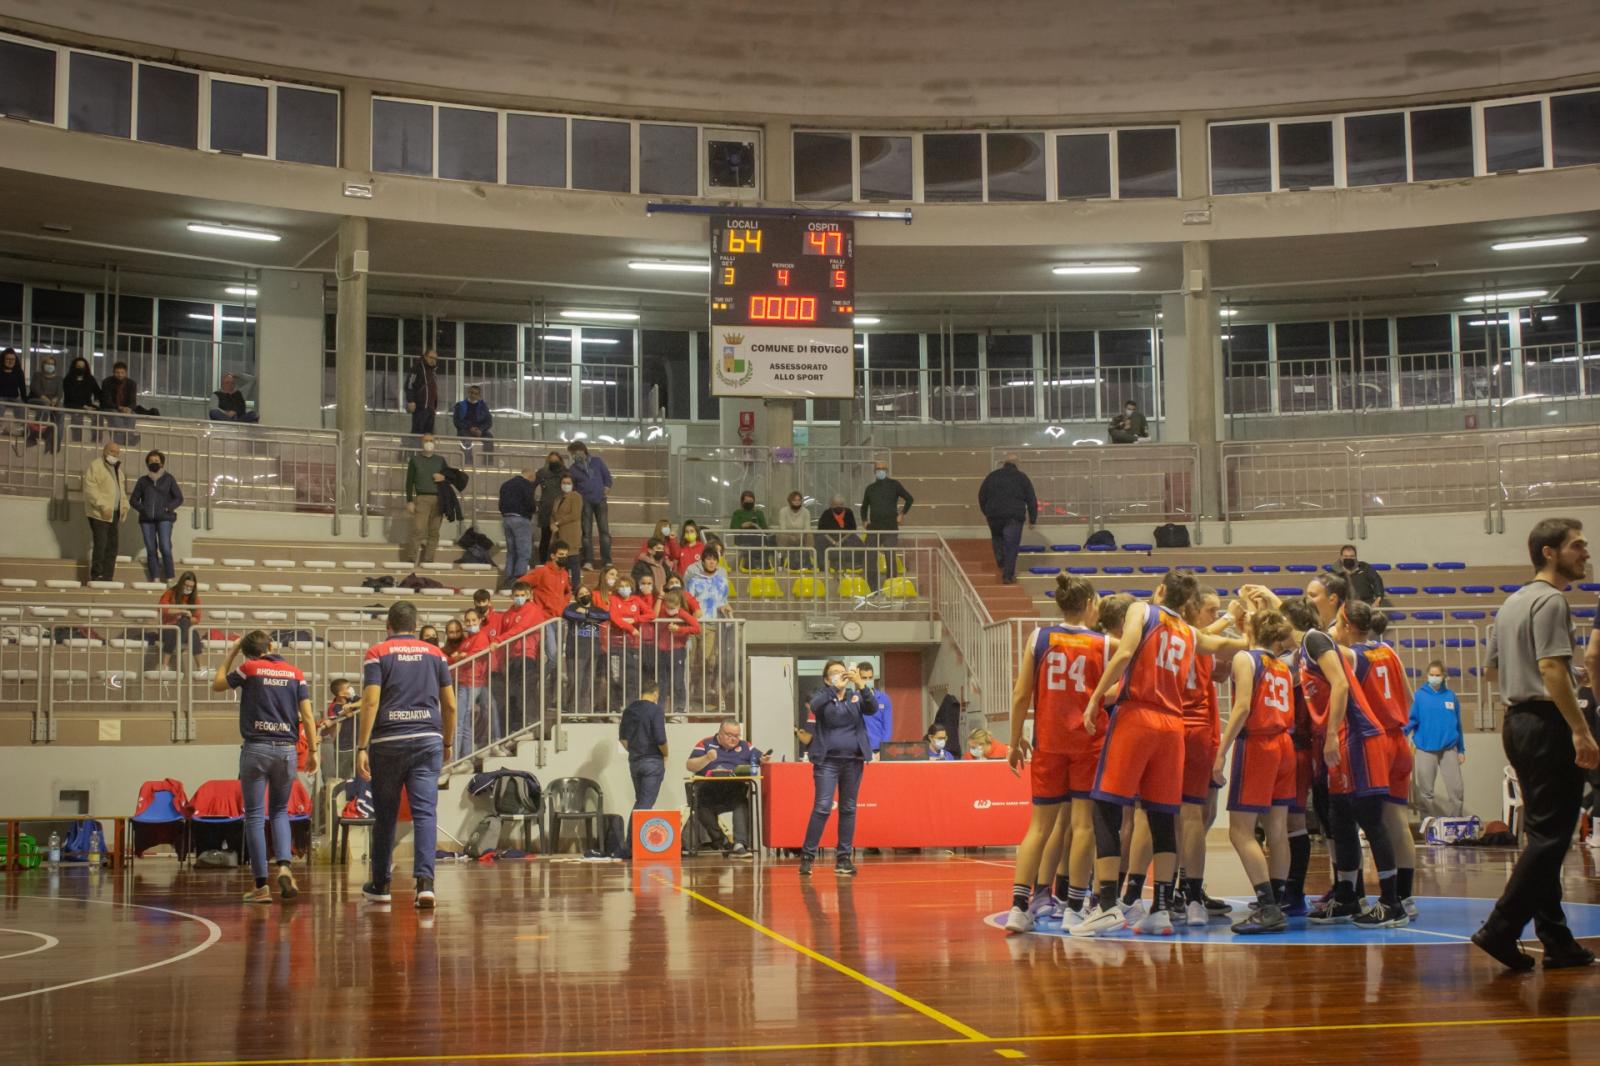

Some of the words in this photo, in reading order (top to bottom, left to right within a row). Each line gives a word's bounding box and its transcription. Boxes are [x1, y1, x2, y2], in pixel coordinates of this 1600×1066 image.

[727, 220, 758, 229] LOCALI
[808, 222, 839, 232] OSPITI
[729, 228, 762, 253] 64
[810, 232, 842, 256] 47
[724, 267, 735, 286] 3
[778, 270, 788, 287] 4
[834, 270, 846, 288] 5
[751, 344, 795, 353] COMUNE
[797, 344, 808, 353] DI
[810, 345, 849, 354] ROVIGO
[769, 363, 829, 371] ASSESSORATO
[774, 373, 795, 381] ALLO
[397, 654, 424, 662] BASKET
[1156, 630, 1186, 674] 12
[1046, 651, 1087, 693] 24
[263, 677, 289, 687] BASKET
[1375, 665, 1392, 700] 7
[1263, 671, 1290, 714] 33
[388, 709, 432, 721] BEREZIARTUA
